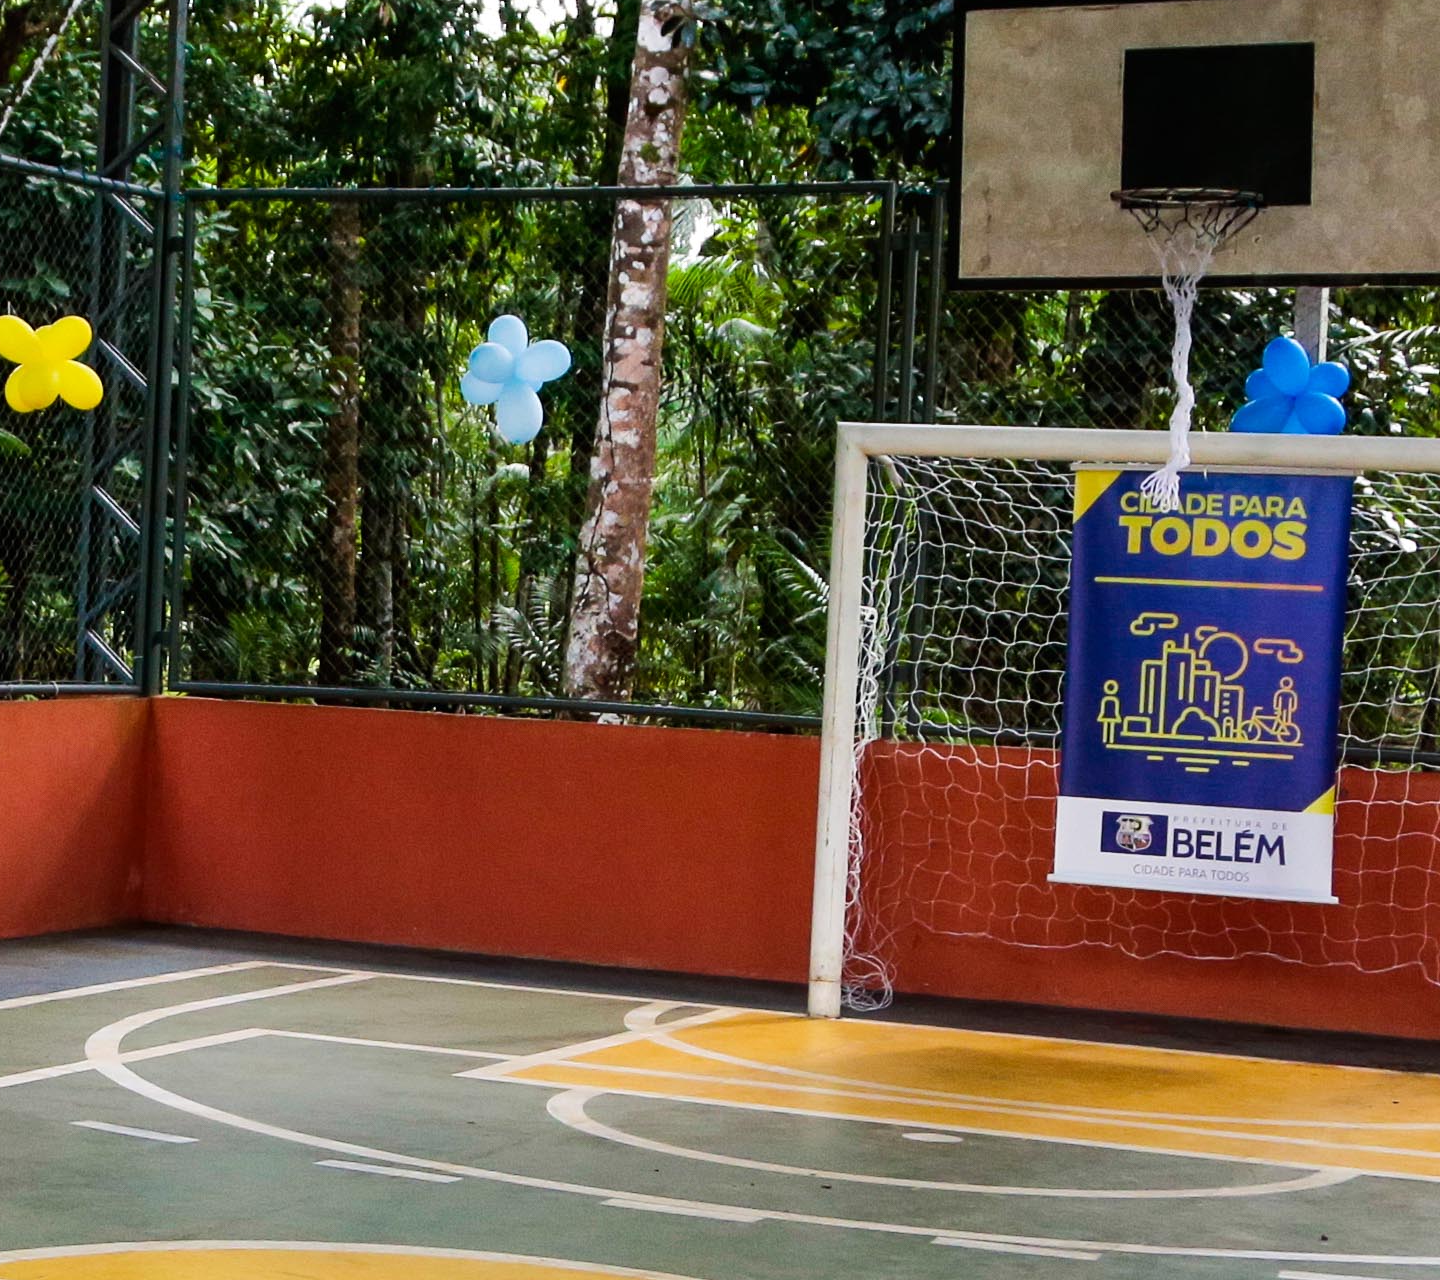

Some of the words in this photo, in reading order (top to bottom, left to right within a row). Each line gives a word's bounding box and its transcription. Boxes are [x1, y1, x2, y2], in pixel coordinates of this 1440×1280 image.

[1120, 490, 1225, 517] CIDE
[1229, 494, 1308, 519] PARA
[1118, 514, 1308, 561] TODOS
[1172, 815, 1262, 828] PREFEITURA
[1271, 821, 1288, 831] DE
[1172, 828, 1286, 866] BELÉM
[1132, 863, 1175, 878] CIDADE
[1178, 866, 1207, 879] PARA
[1211, 869, 1250, 883] TODOS
